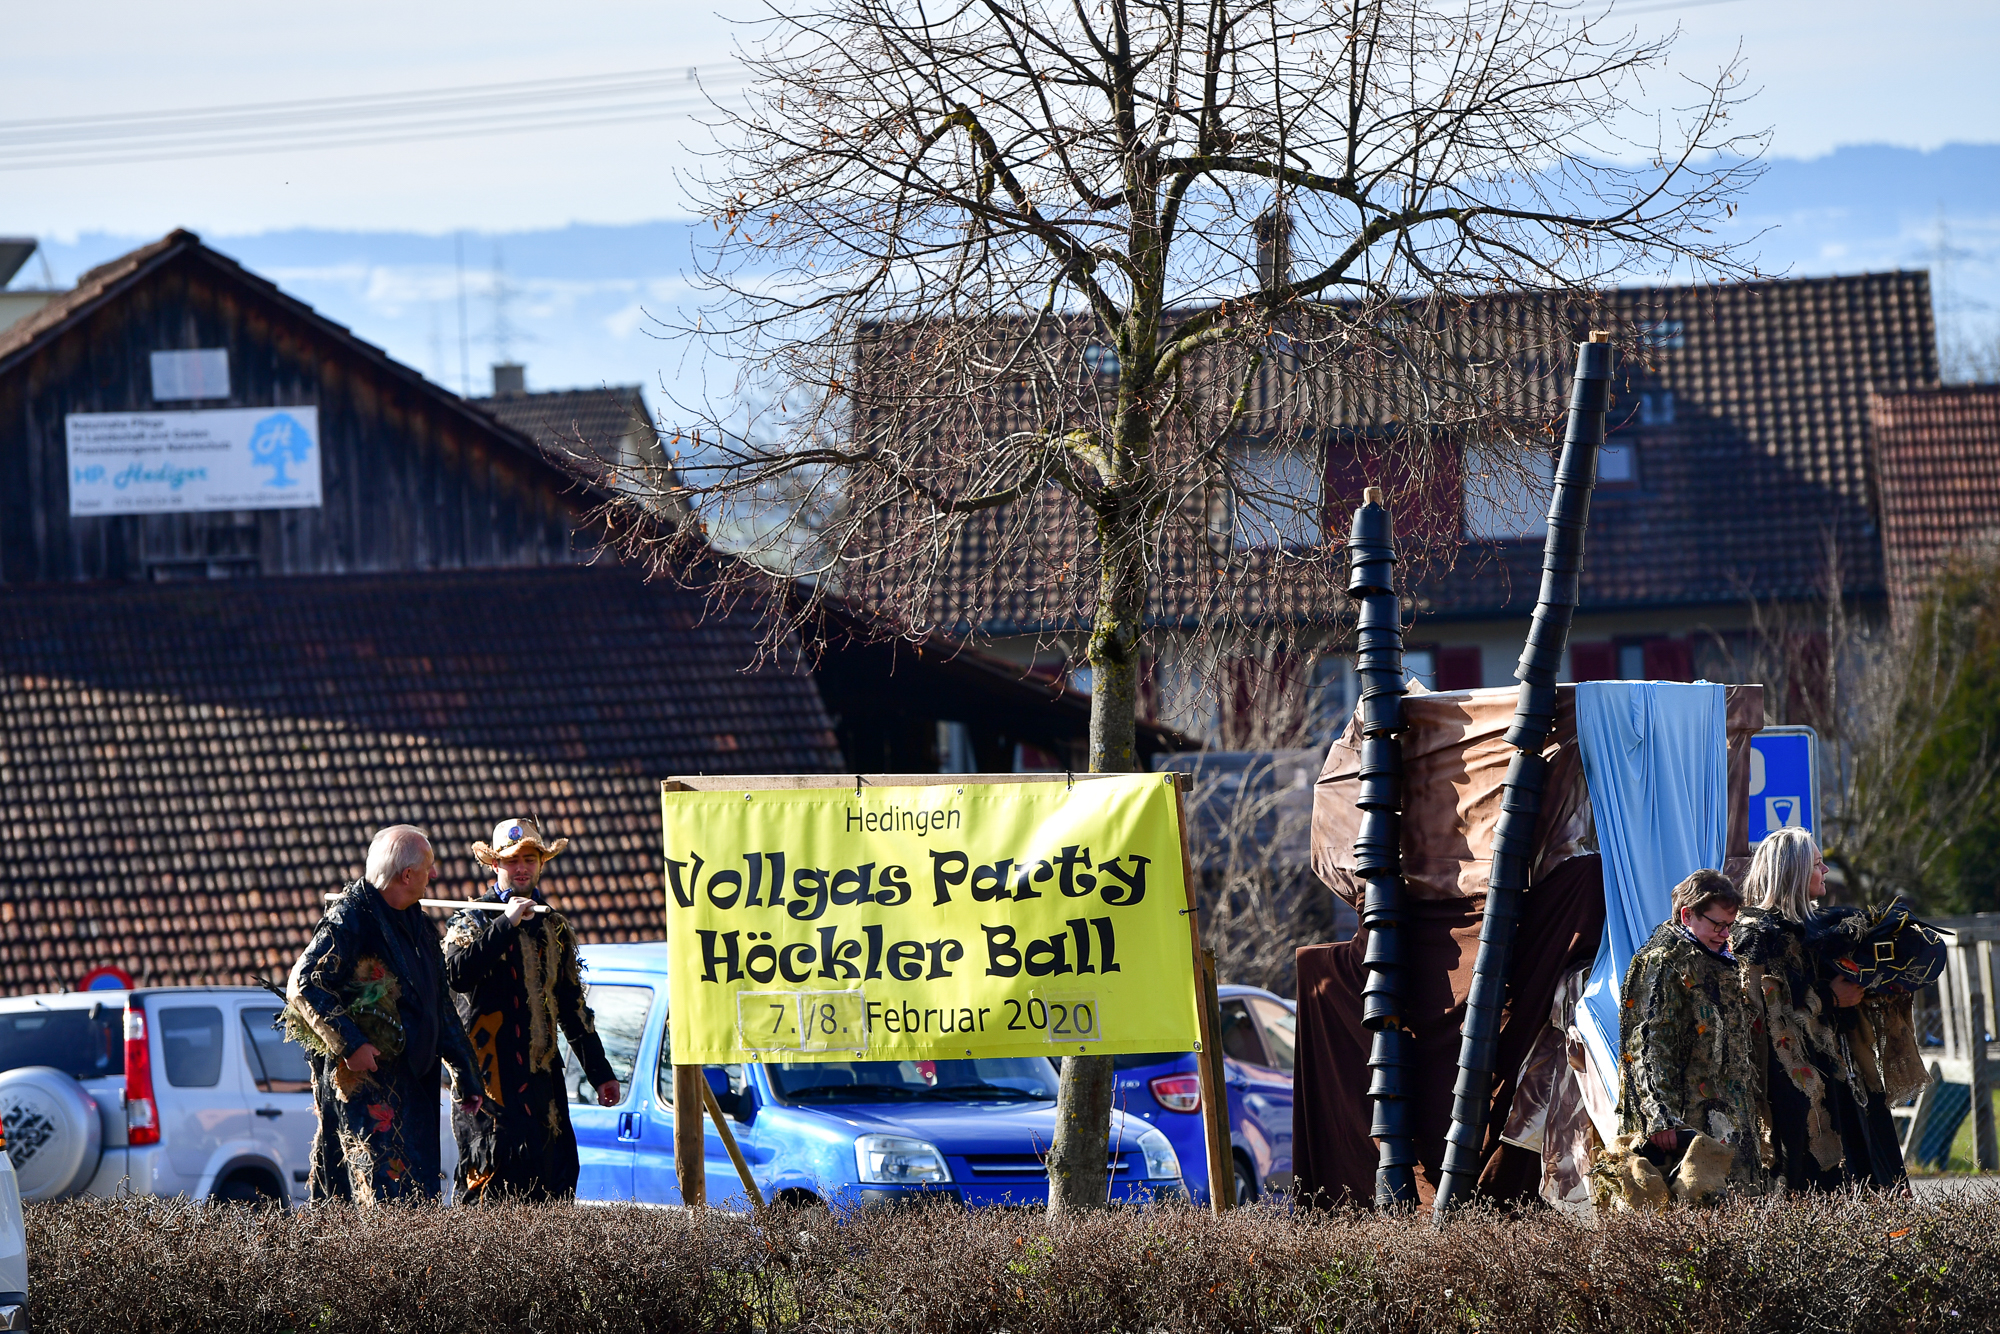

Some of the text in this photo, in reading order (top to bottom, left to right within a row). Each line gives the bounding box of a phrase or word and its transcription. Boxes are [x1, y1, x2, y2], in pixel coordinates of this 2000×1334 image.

[847, 806, 960, 836] Hedingen
[664, 845, 1151, 921] Vollgas Party
[696, 916, 1121, 983] Höckler Ball
[867, 1001, 991, 1034] Februar
[1007, 998, 1093, 1035] 2020
